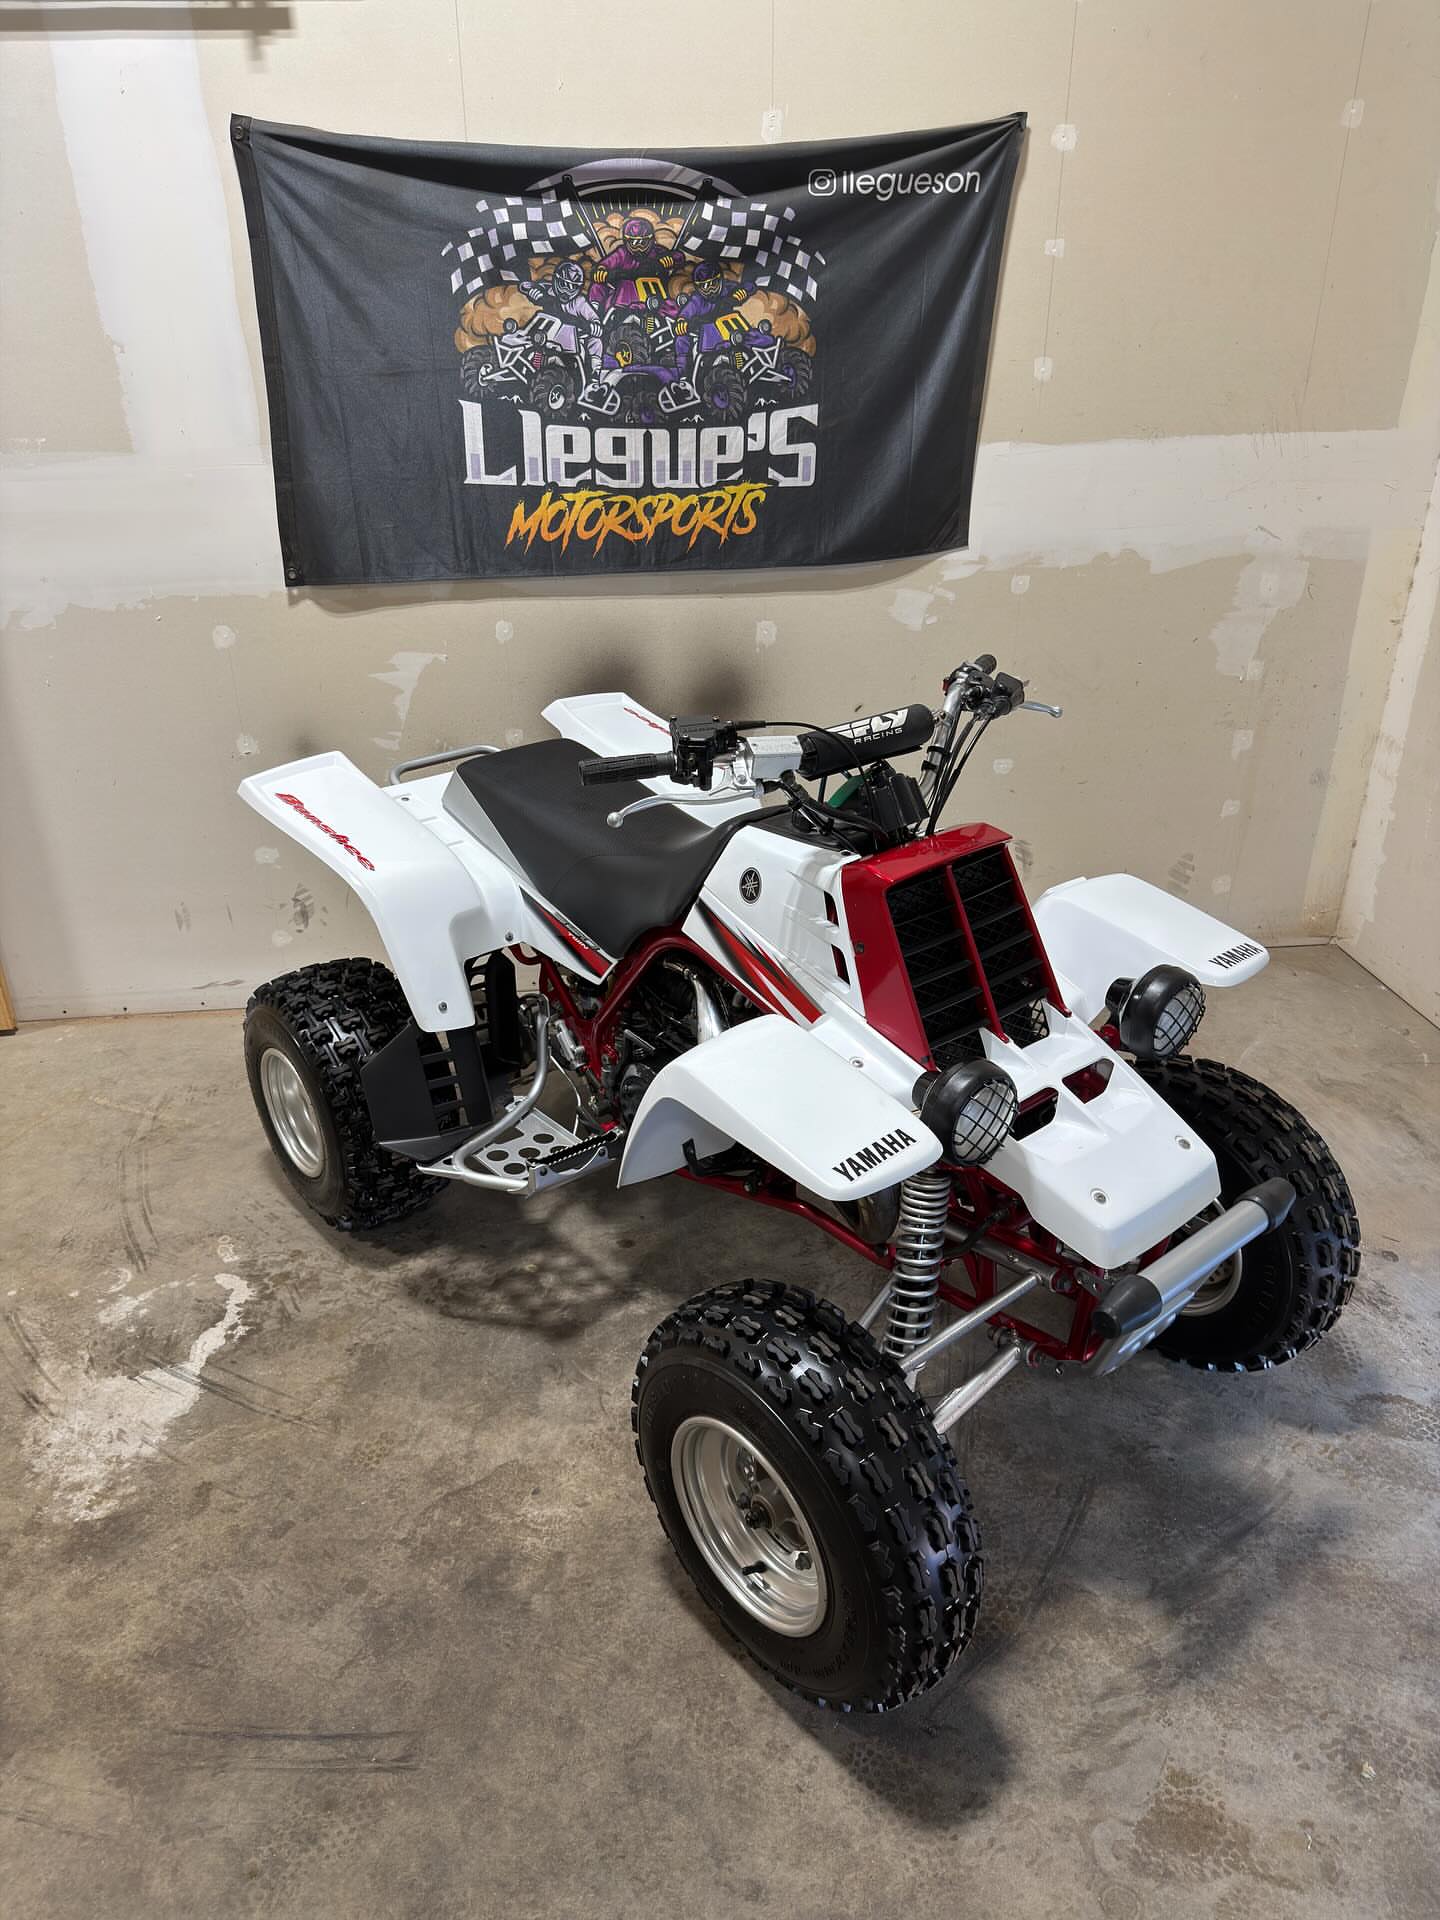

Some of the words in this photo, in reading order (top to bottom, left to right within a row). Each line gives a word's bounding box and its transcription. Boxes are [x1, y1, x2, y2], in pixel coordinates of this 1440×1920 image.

[504, 480, 773, 558] MOTORSPORTS
[826, 708, 909, 739] FLY
[853, 727, 903, 745] RACING
[274, 793, 376, 871] Banshee
[1208, 943, 1264, 969] YAMAHA
[832, 1128, 917, 1182] YAMAHA
